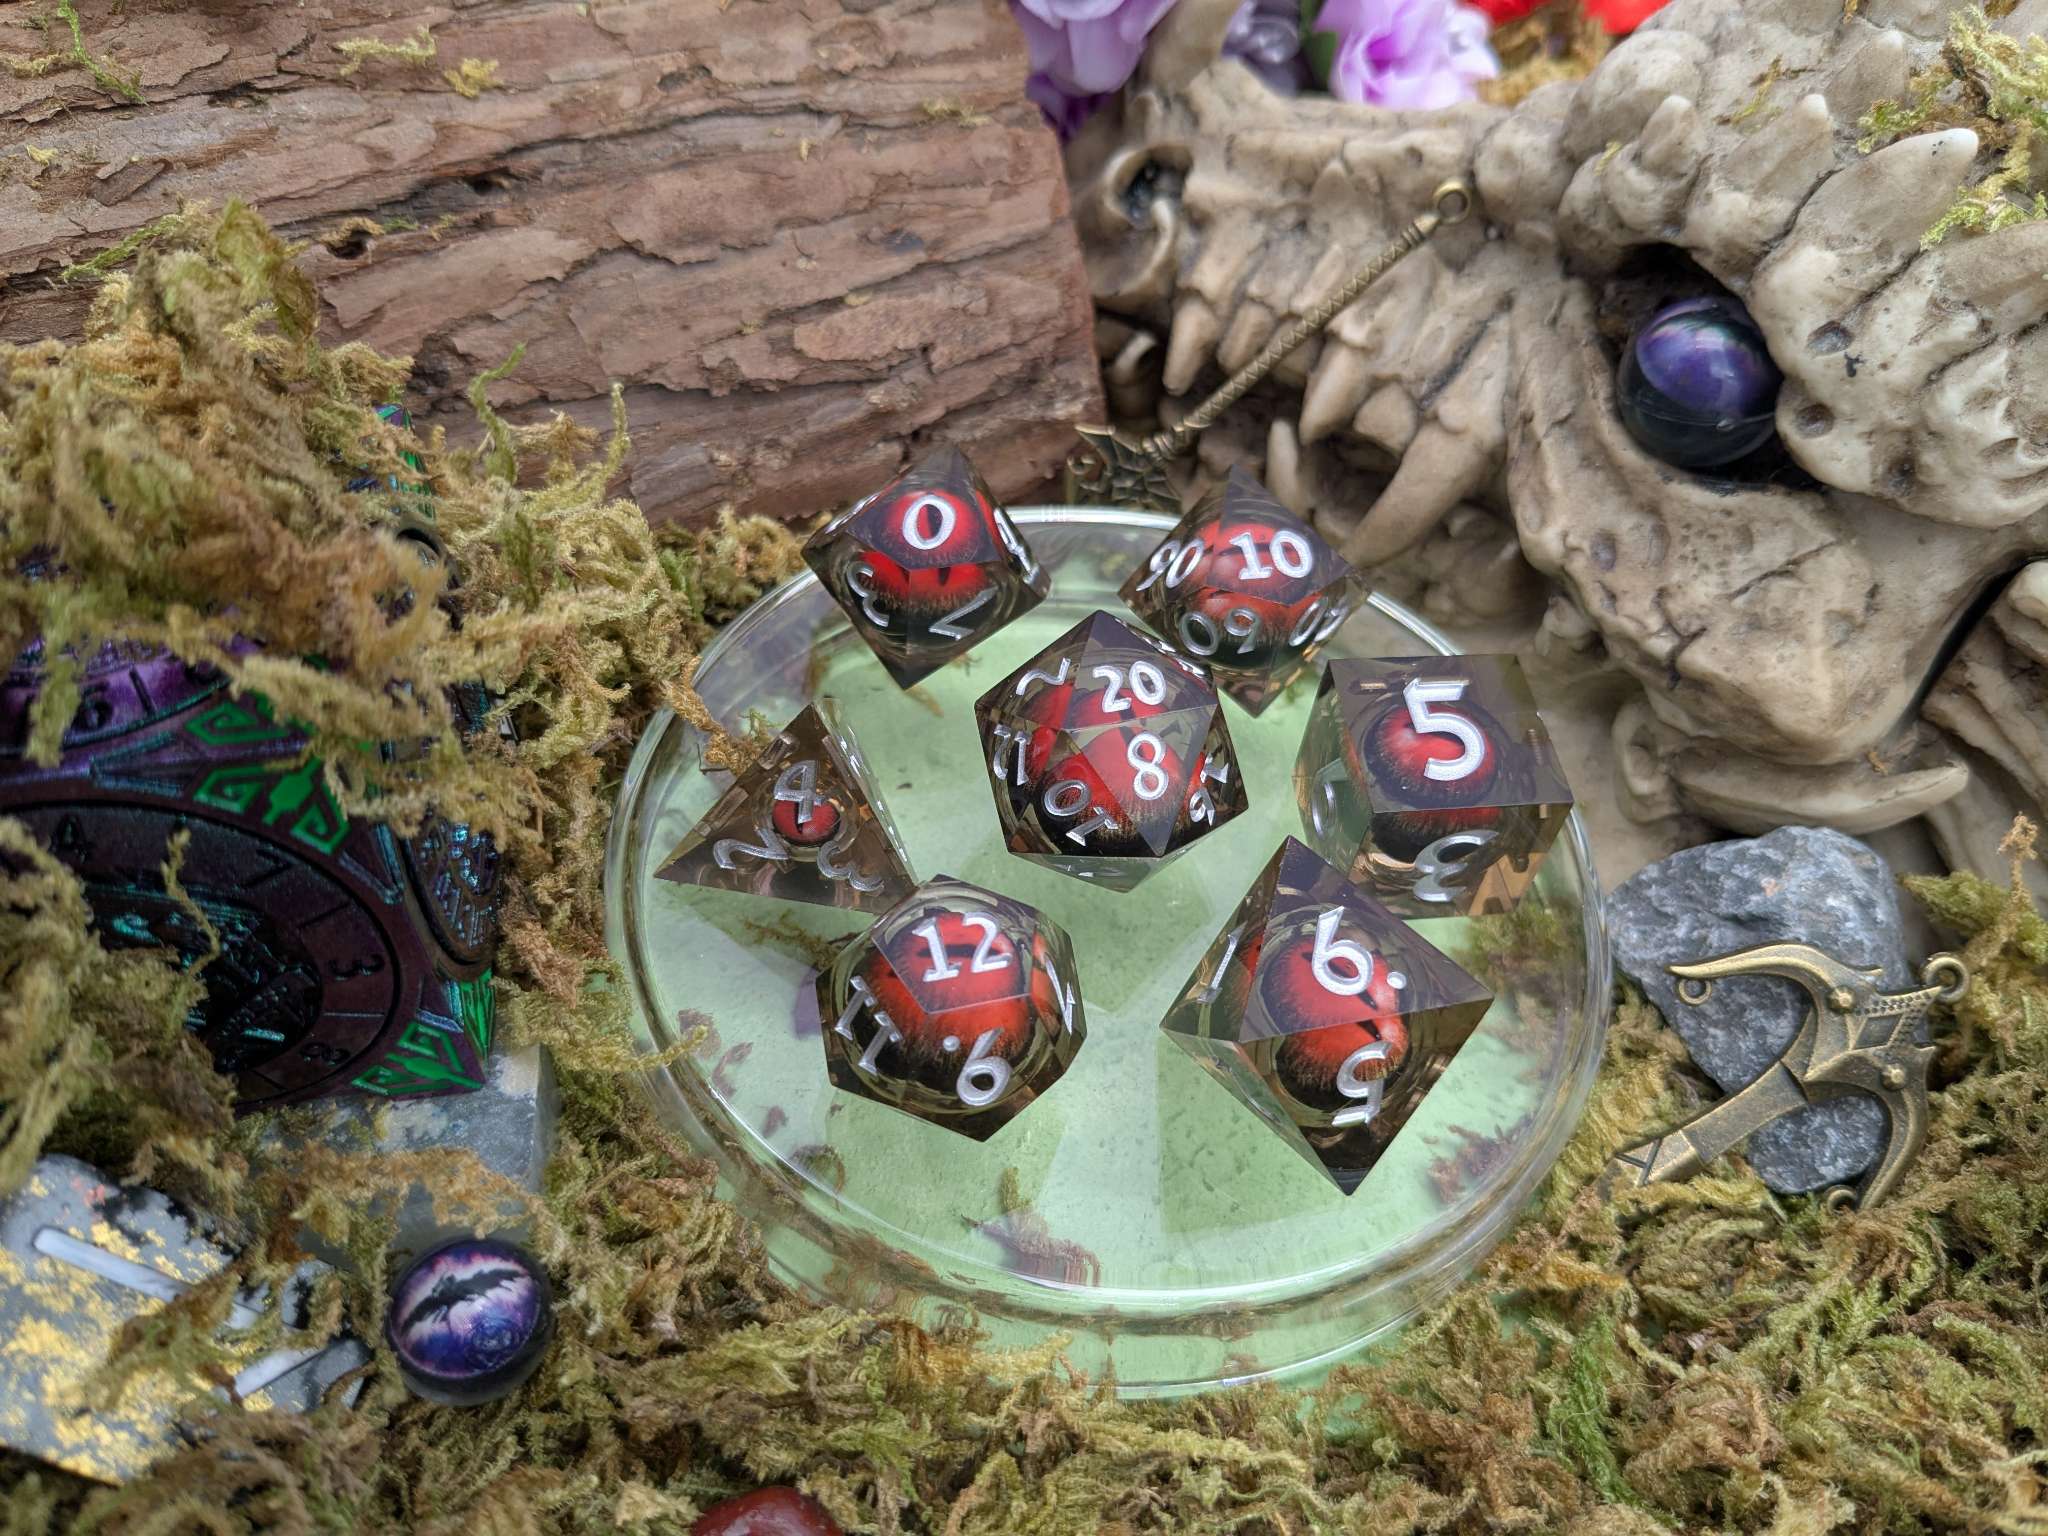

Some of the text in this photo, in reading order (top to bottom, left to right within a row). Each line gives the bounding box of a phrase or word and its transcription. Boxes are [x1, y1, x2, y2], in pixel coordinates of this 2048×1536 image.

[902, 495, 956, 550] 0
[1136, 539, 1205, 592] 90
[1229, 528, 1314, 585] 10
[848, 560, 890, 628] 3
[1092, 660, 1168, 713] 20
[1403, 677, 1471, 782] 5
[774, 759, 824, 824] 4
[1127, 730, 1169, 801] 8
[912, 911, 1013, 983] 12
[834, 975, 903, 1076] 11
